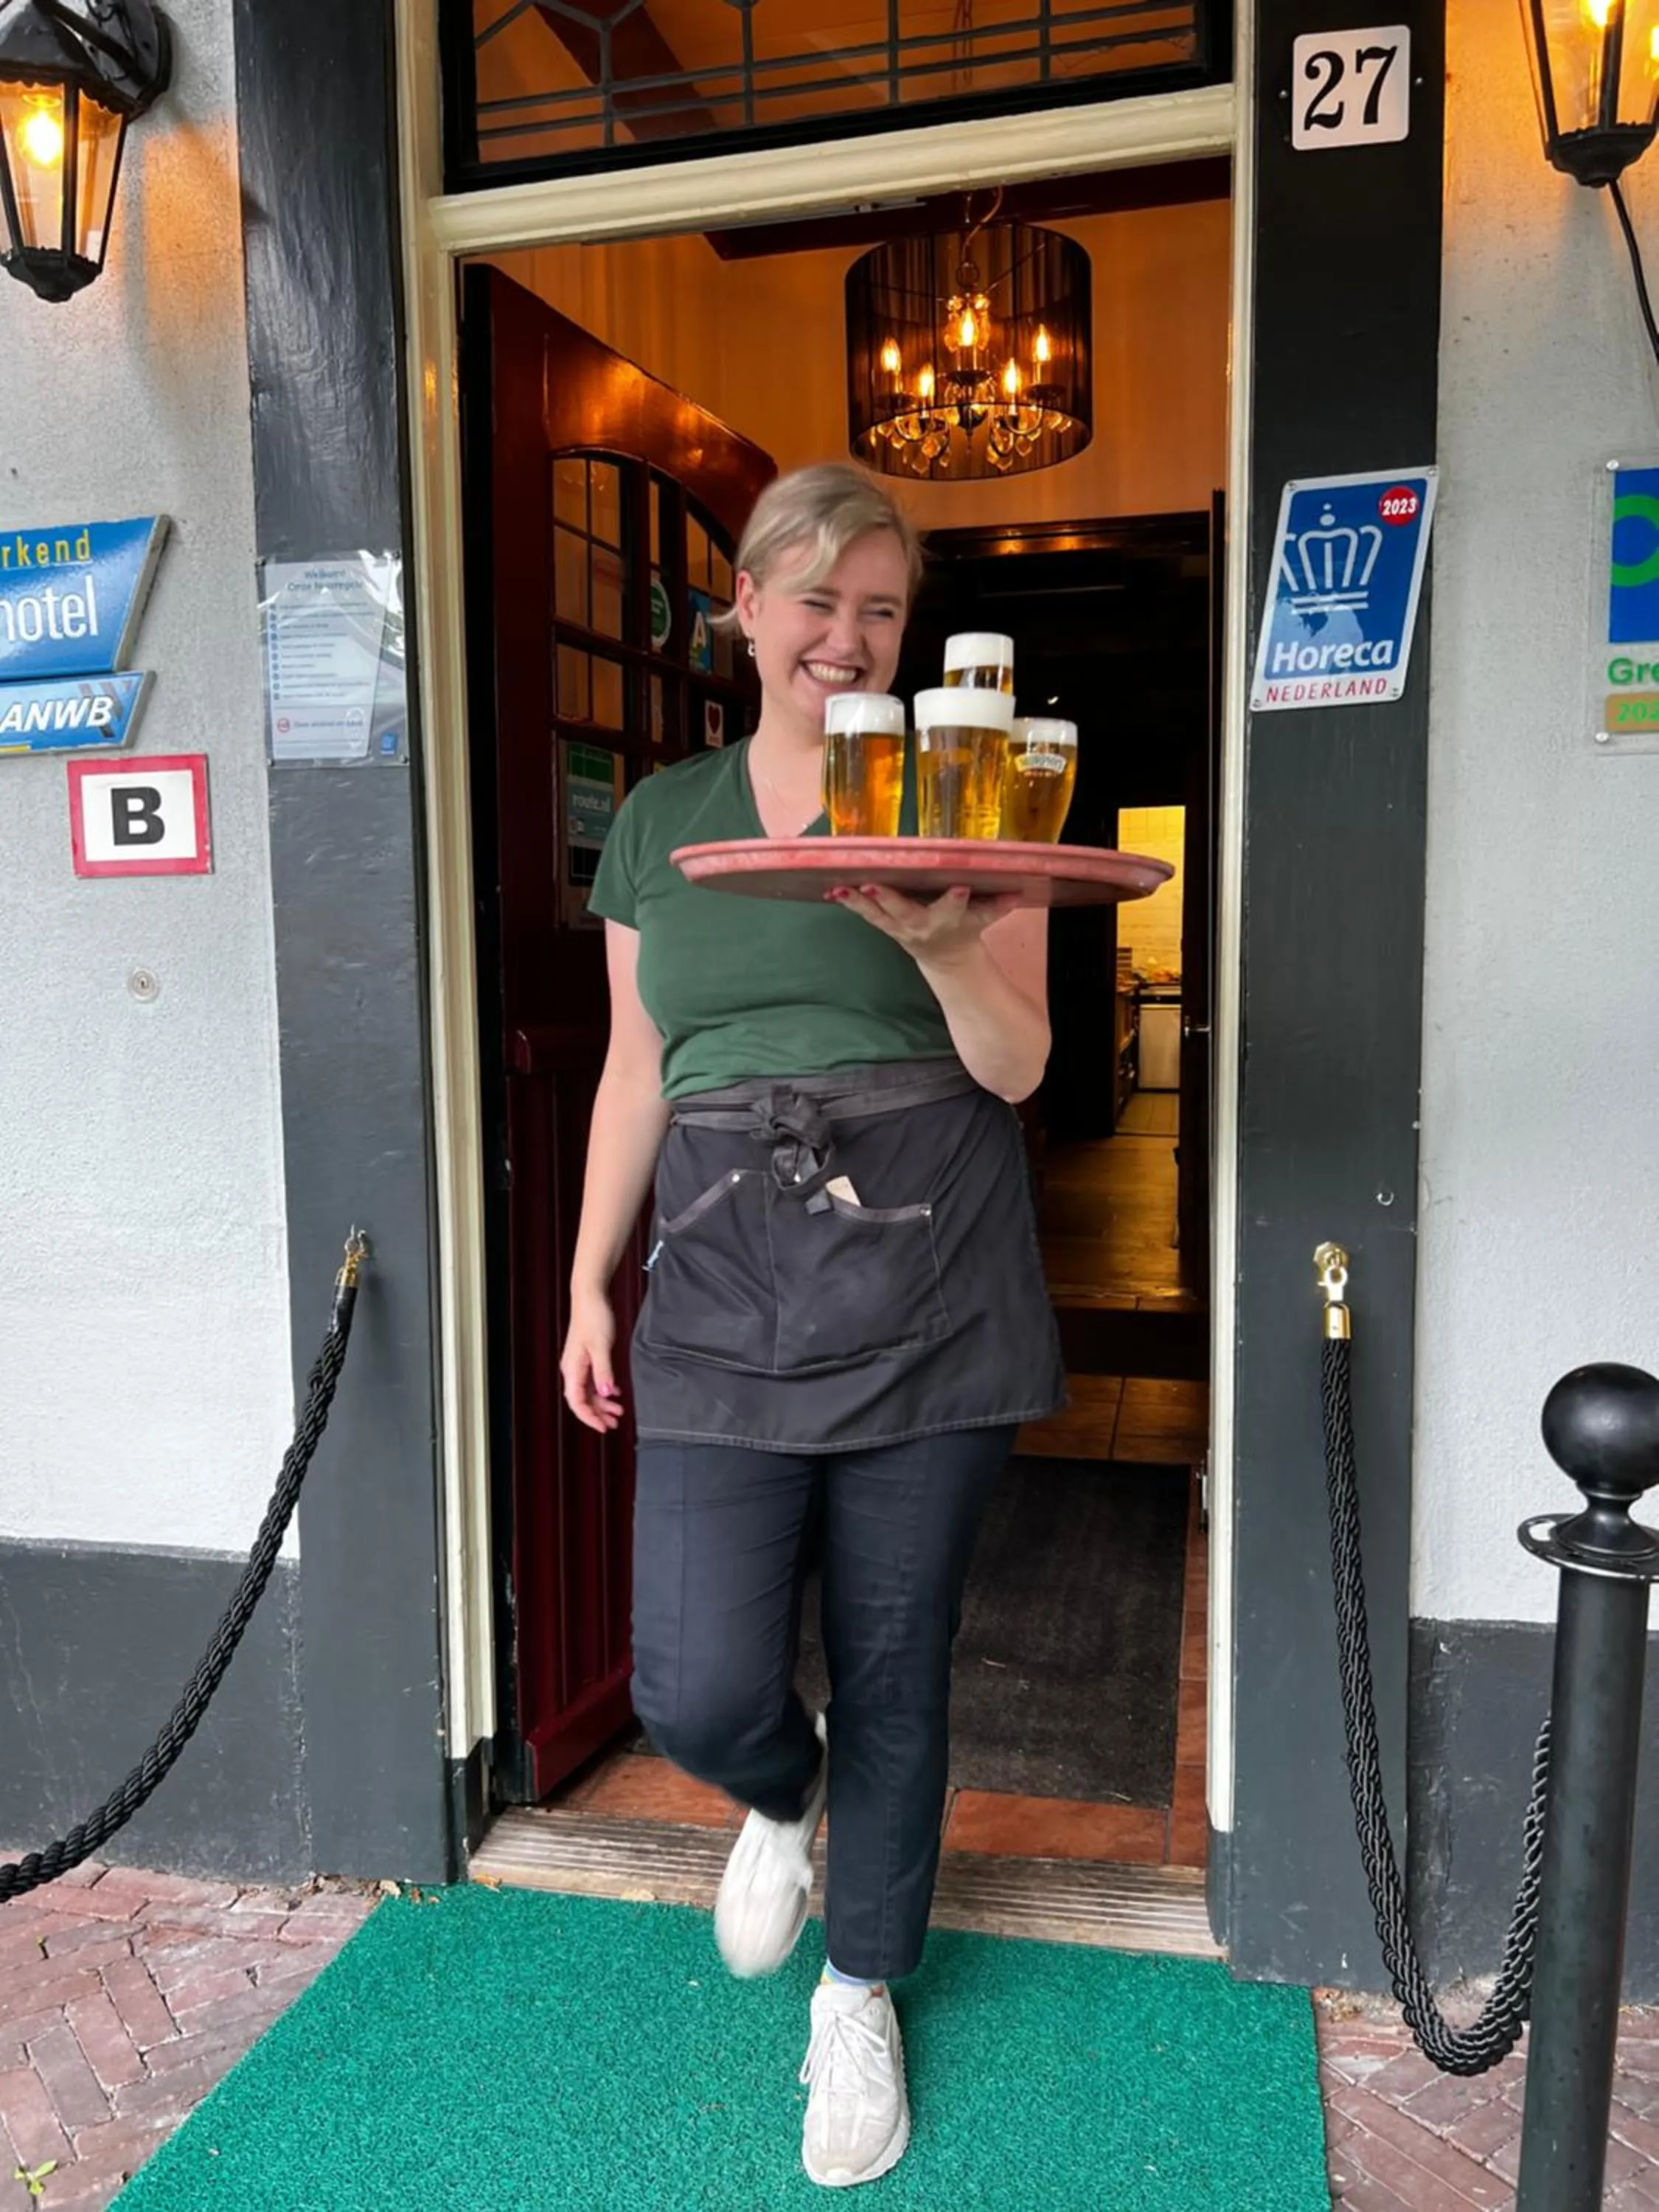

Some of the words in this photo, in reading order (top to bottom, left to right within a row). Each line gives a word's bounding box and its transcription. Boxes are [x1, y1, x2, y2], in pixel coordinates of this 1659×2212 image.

[1304, 45, 1397, 131] 27
[1382, 497, 1417, 515] 2023
[1, 528, 90, 567] rkend
[1272, 639, 1394, 672] Horeca
[1266, 678, 1388, 702] NEDERLAND
[0, 695, 113, 733] ANWB
[111, 786, 166, 846] B
